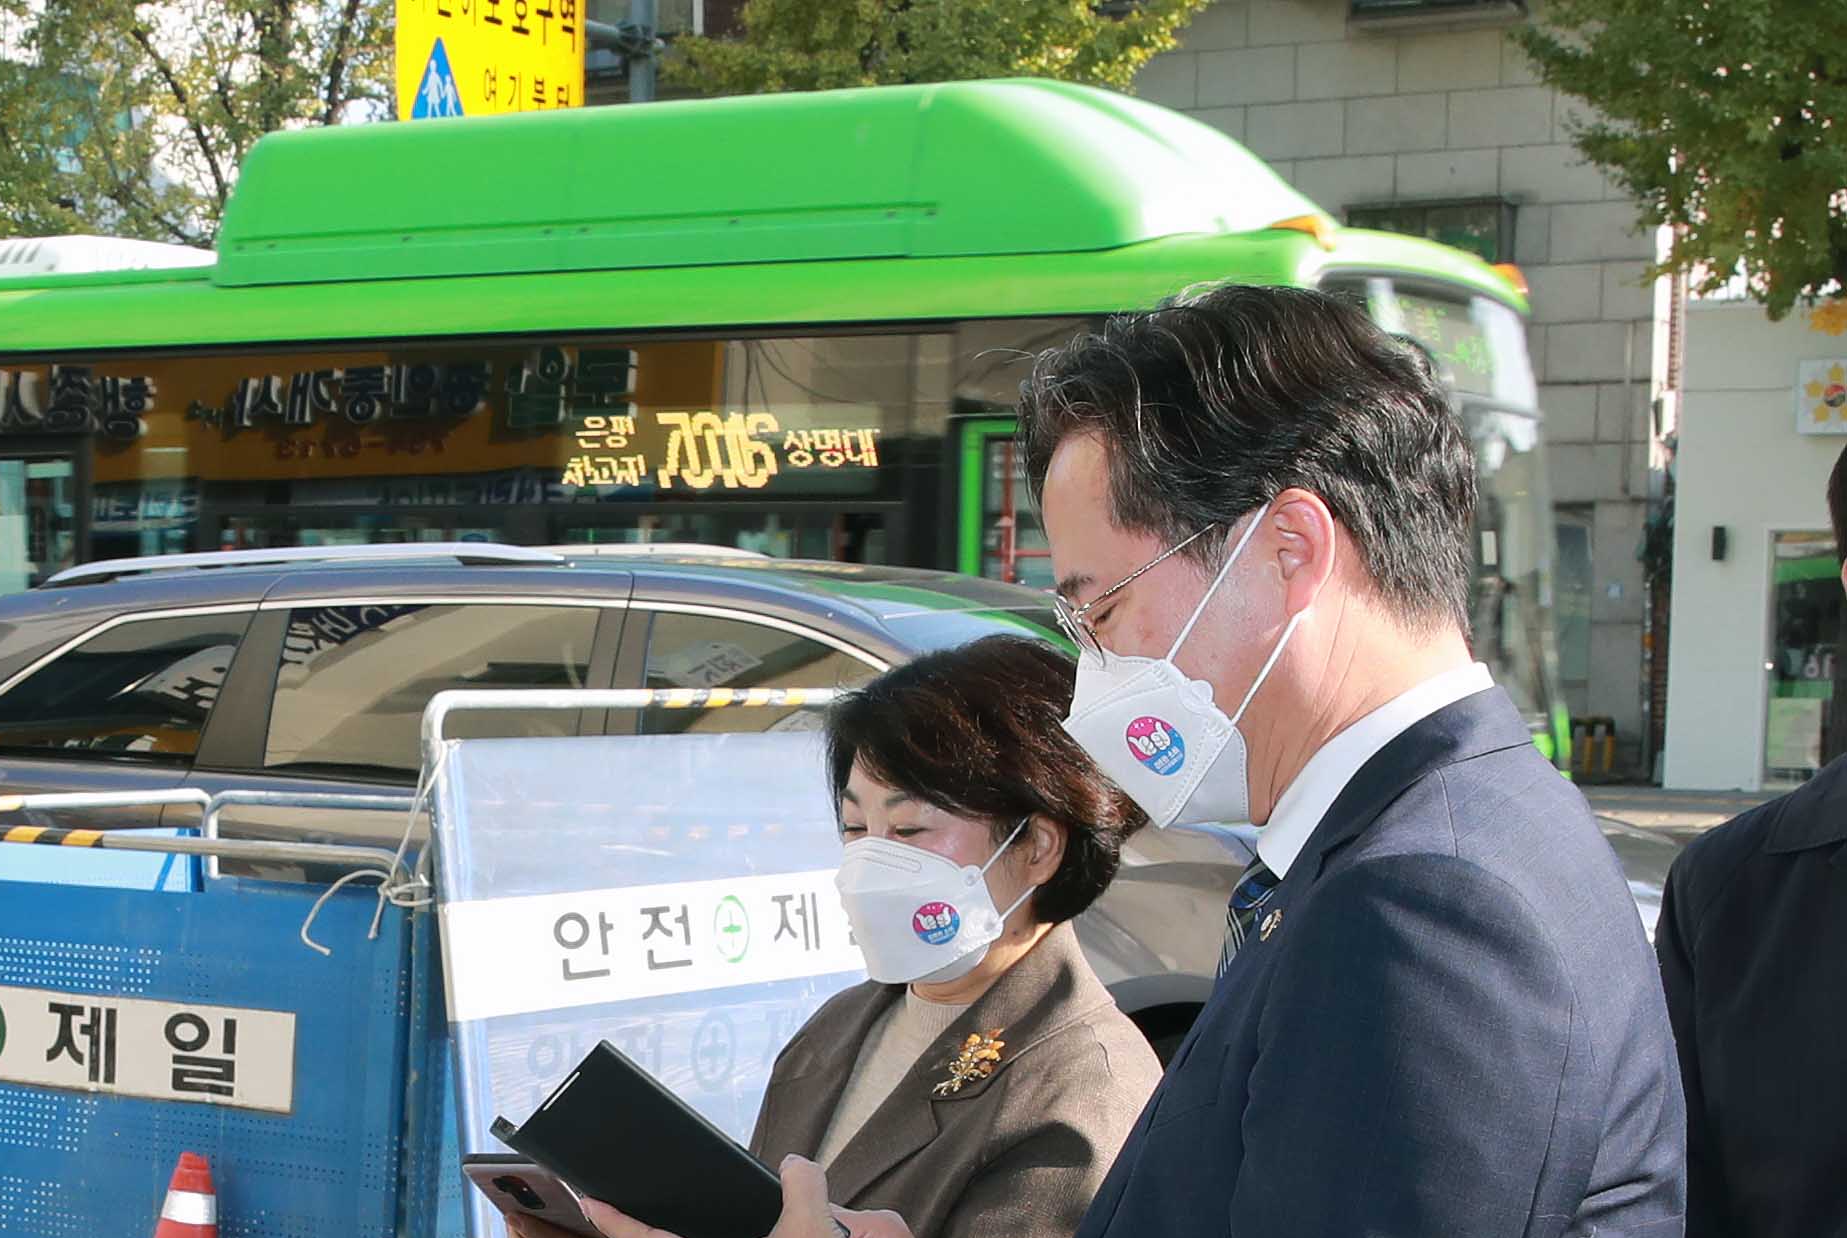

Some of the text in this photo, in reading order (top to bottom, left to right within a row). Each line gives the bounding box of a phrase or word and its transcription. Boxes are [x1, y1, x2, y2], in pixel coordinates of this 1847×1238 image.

[576, 415, 635, 449] 은평
[783, 428, 880, 468] 상명대
[562, 454, 647, 488] 차고지
[553, 903, 693, 984] 안전
[45, 1000, 240, 1099] 제일
